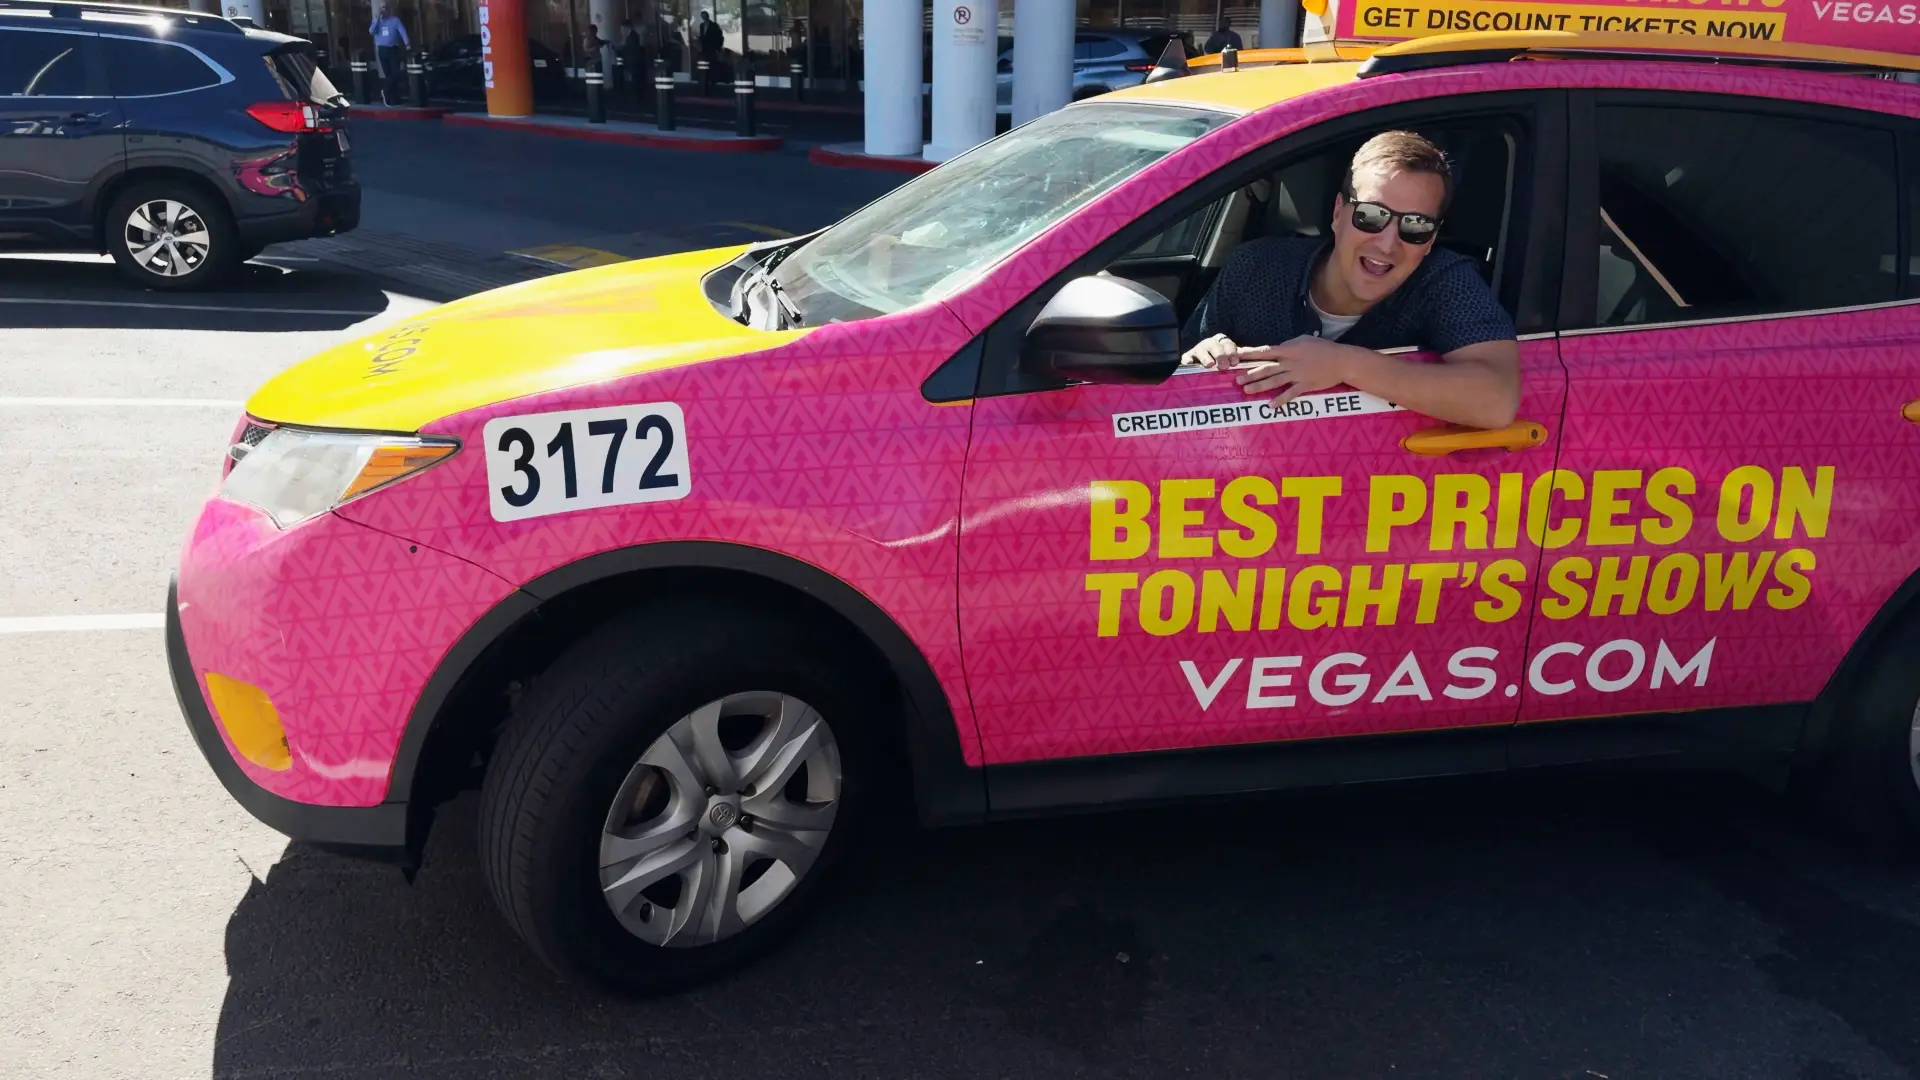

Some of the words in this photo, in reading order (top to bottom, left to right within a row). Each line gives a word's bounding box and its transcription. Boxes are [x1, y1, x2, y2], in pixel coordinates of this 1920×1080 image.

[1363, 6, 1420, 28] GET
[1427, 9, 1572, 32] DISCOUNT
[1579, 15, 1697, 36] TICKETS
[1706, 20, 1776, 41] NOW
[1117, 404, 1253, 433] CREDIT/DEBIT
[1258, 397, 1320, 420] CARD,
[1324, 394, 1363, 414] FEE
[498, 414, 680, 508] 3172
[1090, 475, 1342, 561] BEST
[1366, 466, 1697, 553] PRICES
[1717, 465, 1836, 542] ON
[1541, 548, 1816, 620] SHOWS
[1178, 637, 1717, 711] VEGAS.COM
